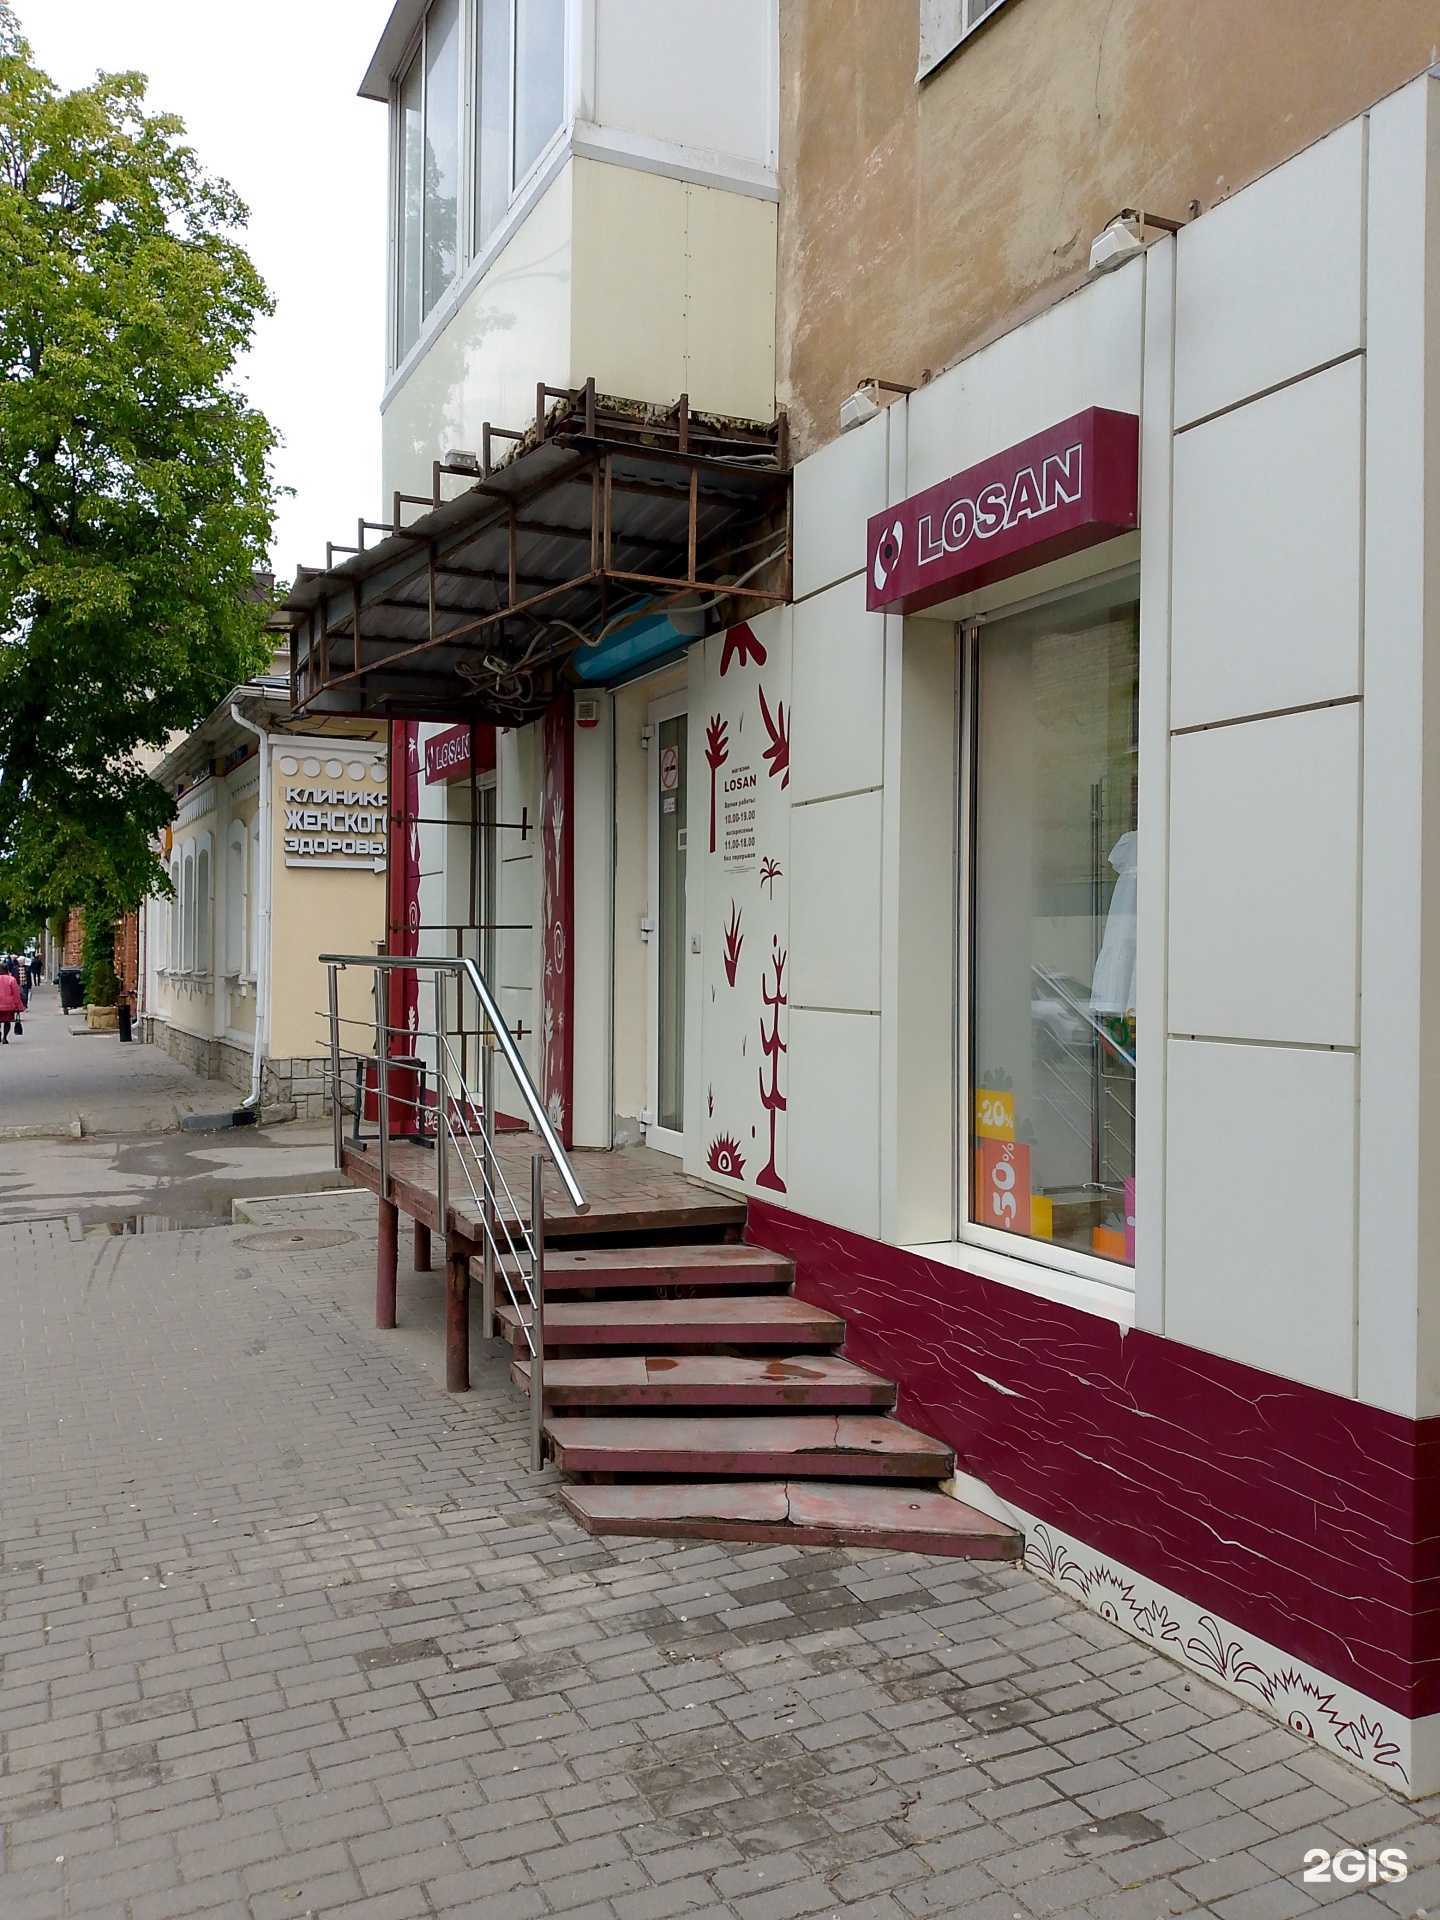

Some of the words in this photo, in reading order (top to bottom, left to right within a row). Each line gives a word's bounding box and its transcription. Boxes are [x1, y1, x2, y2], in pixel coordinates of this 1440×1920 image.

[918, 443, 1083, 566] LOSAN
[724, 774, 756, 792] LOSAN
[285, 837, 388, 855] ЗДОРОВЬ
[992, 1143, 1017, 1228] -50%
